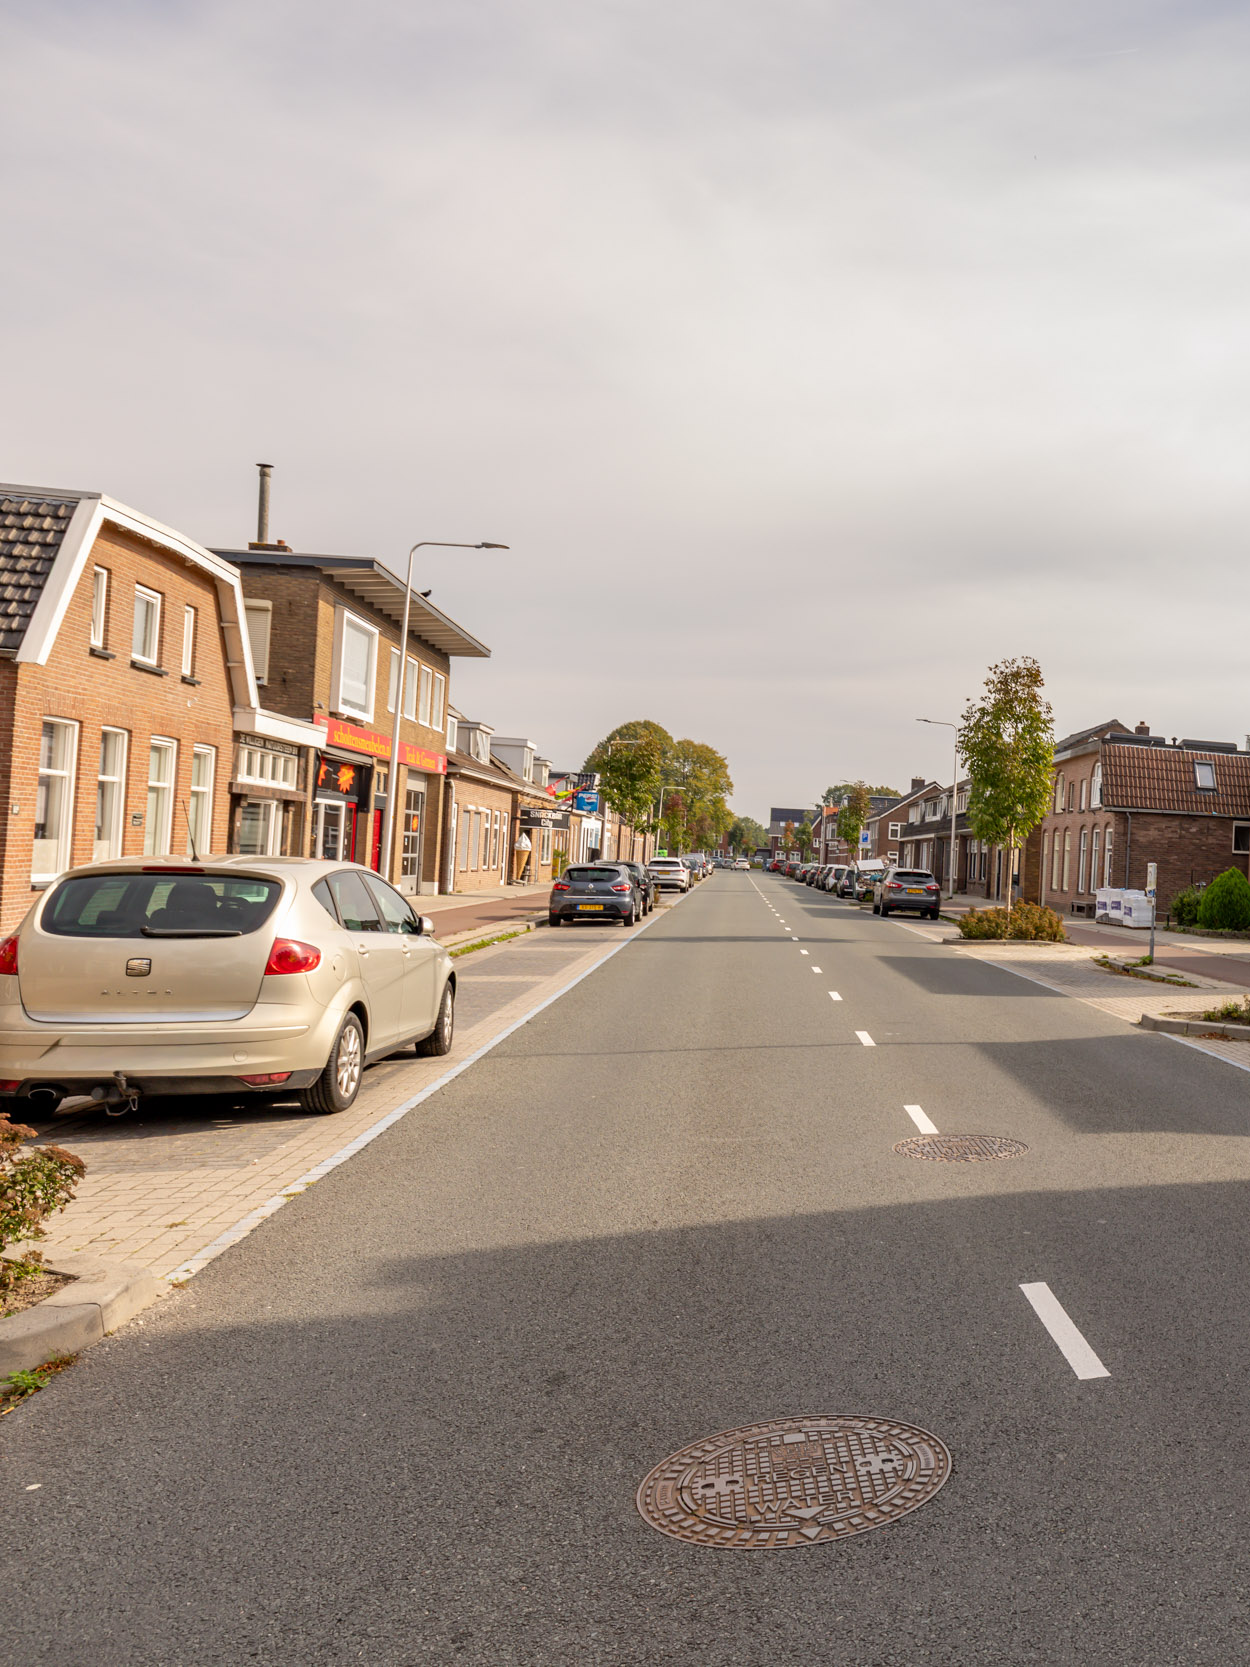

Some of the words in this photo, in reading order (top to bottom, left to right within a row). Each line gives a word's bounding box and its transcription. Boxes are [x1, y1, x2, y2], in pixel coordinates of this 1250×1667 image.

[333, 724, 392, 757] scholtensmeubelen.nl
[530, 810, 563, 820] SNACKBAR
[541, 819, 553, 828] City
[753, 1462, 848, 1485] REGEN
[754, 1490, 856, 1514] WATER
